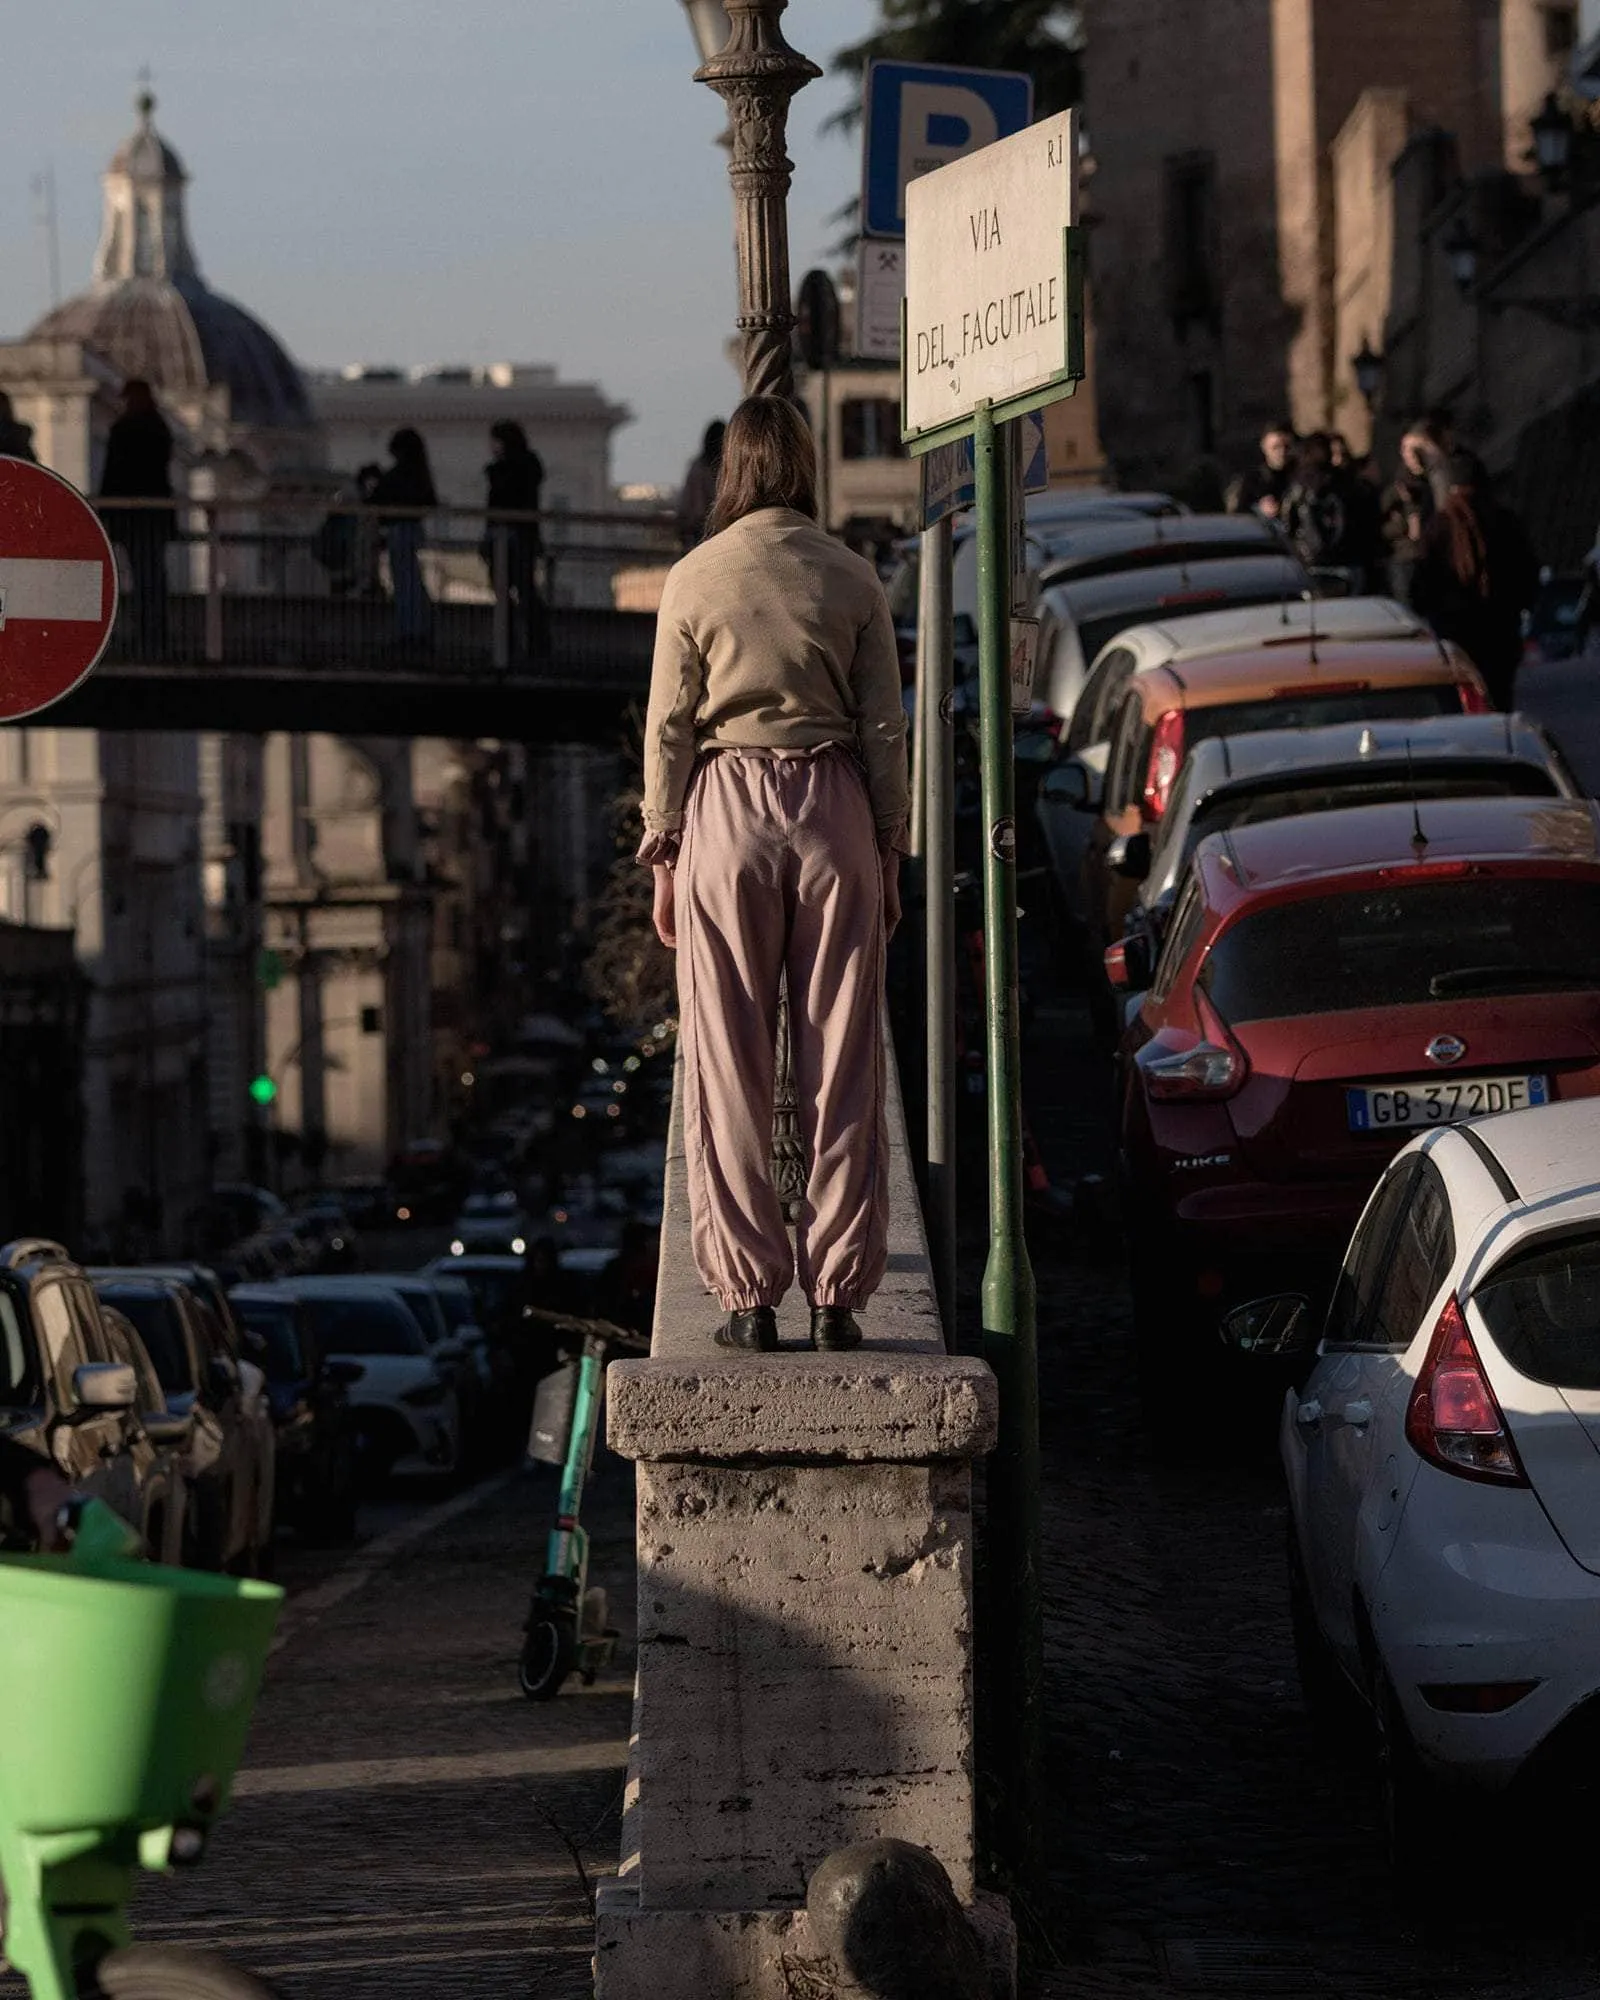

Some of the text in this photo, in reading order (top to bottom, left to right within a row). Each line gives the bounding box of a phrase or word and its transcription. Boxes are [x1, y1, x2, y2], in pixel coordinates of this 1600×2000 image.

[897, 81, 999, 219] P
[970, 206, 1002, 251] VIA
[917, 277, 1057, 374] DEL FAGUTALE
[1373, 1092, 1411, 1123] GB
